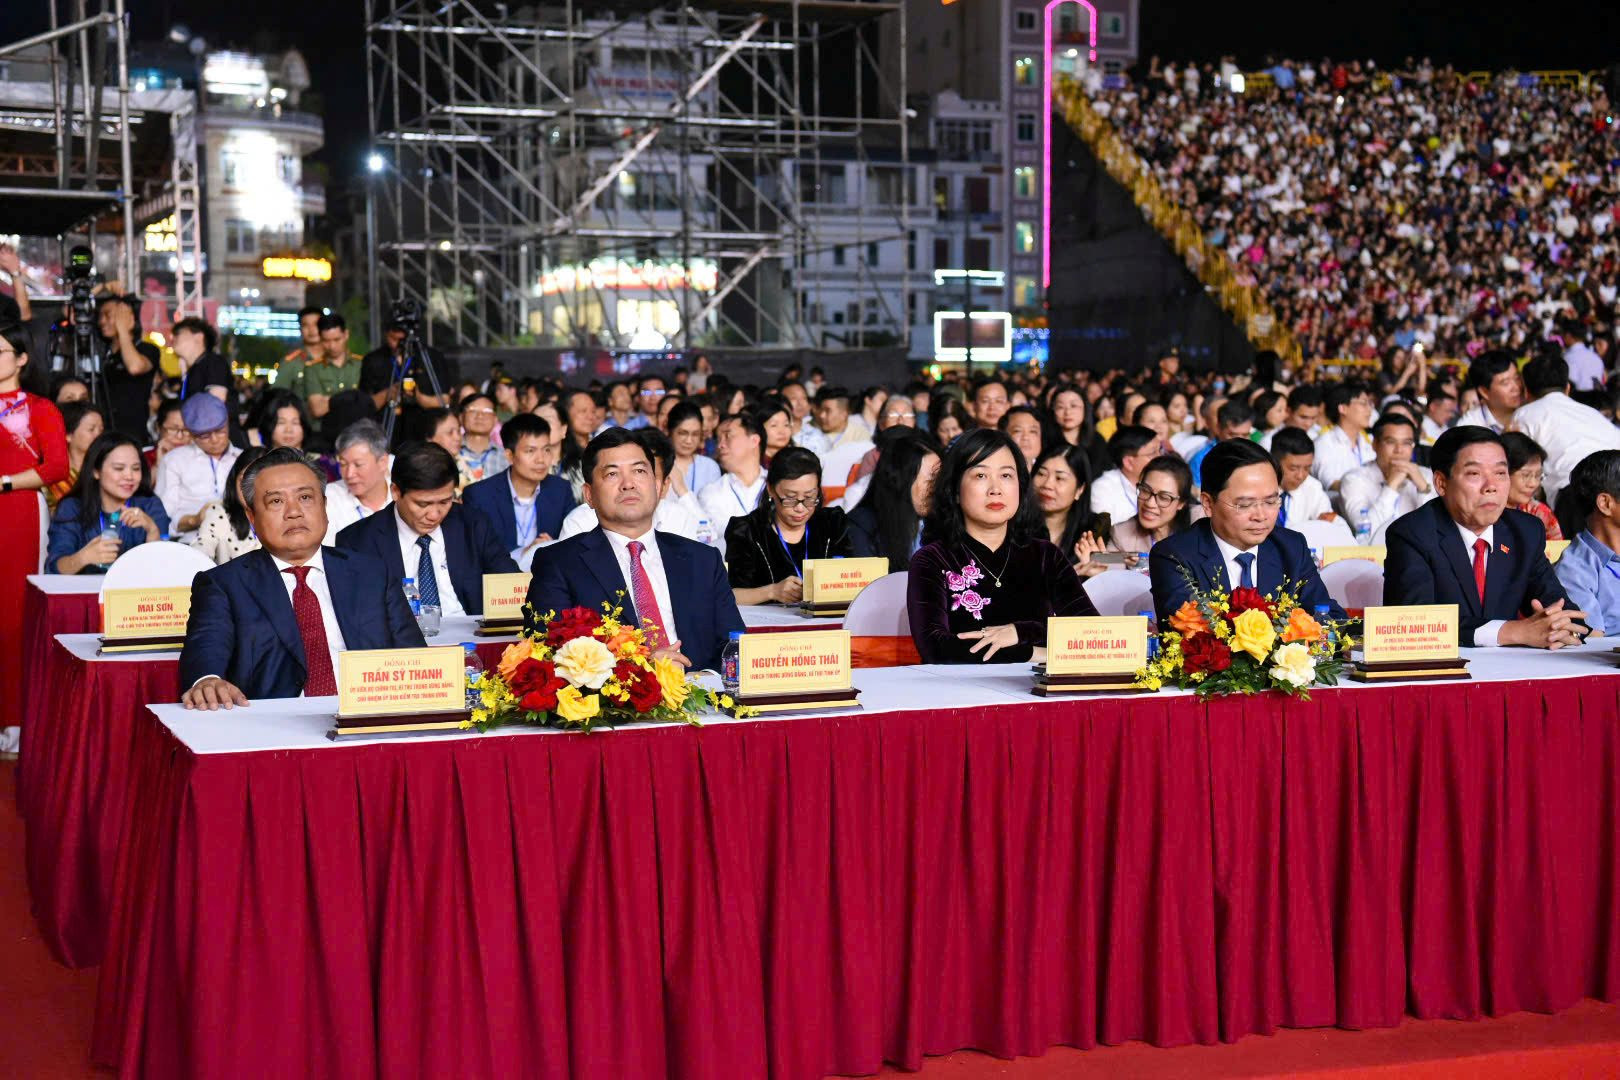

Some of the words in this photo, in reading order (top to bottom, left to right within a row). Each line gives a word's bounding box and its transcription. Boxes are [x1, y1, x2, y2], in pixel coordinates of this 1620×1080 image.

[138, 604, 154, 612] MAI
[156, 603, 173, 612] SƠN
[1376, 622, 1406, 635] NGUYỄN
[1409, 625, 1424, 634] ANH
[1428, 620, 1447, 633] TUẤN
[1068, 638, 1084, 650] ĐÀO
[1086, 637, 1108, 649] HỒNG
[1111, 639, 1126, 648] LAN
[752, 653, 788, 668] NGUYỄN
[792, 653, 816, 666] HỒNG
[819, 653, 839, 665] THÁI
[362, 668, 389, 683] TRẦN
[409, 669, 442, 680] THANH
